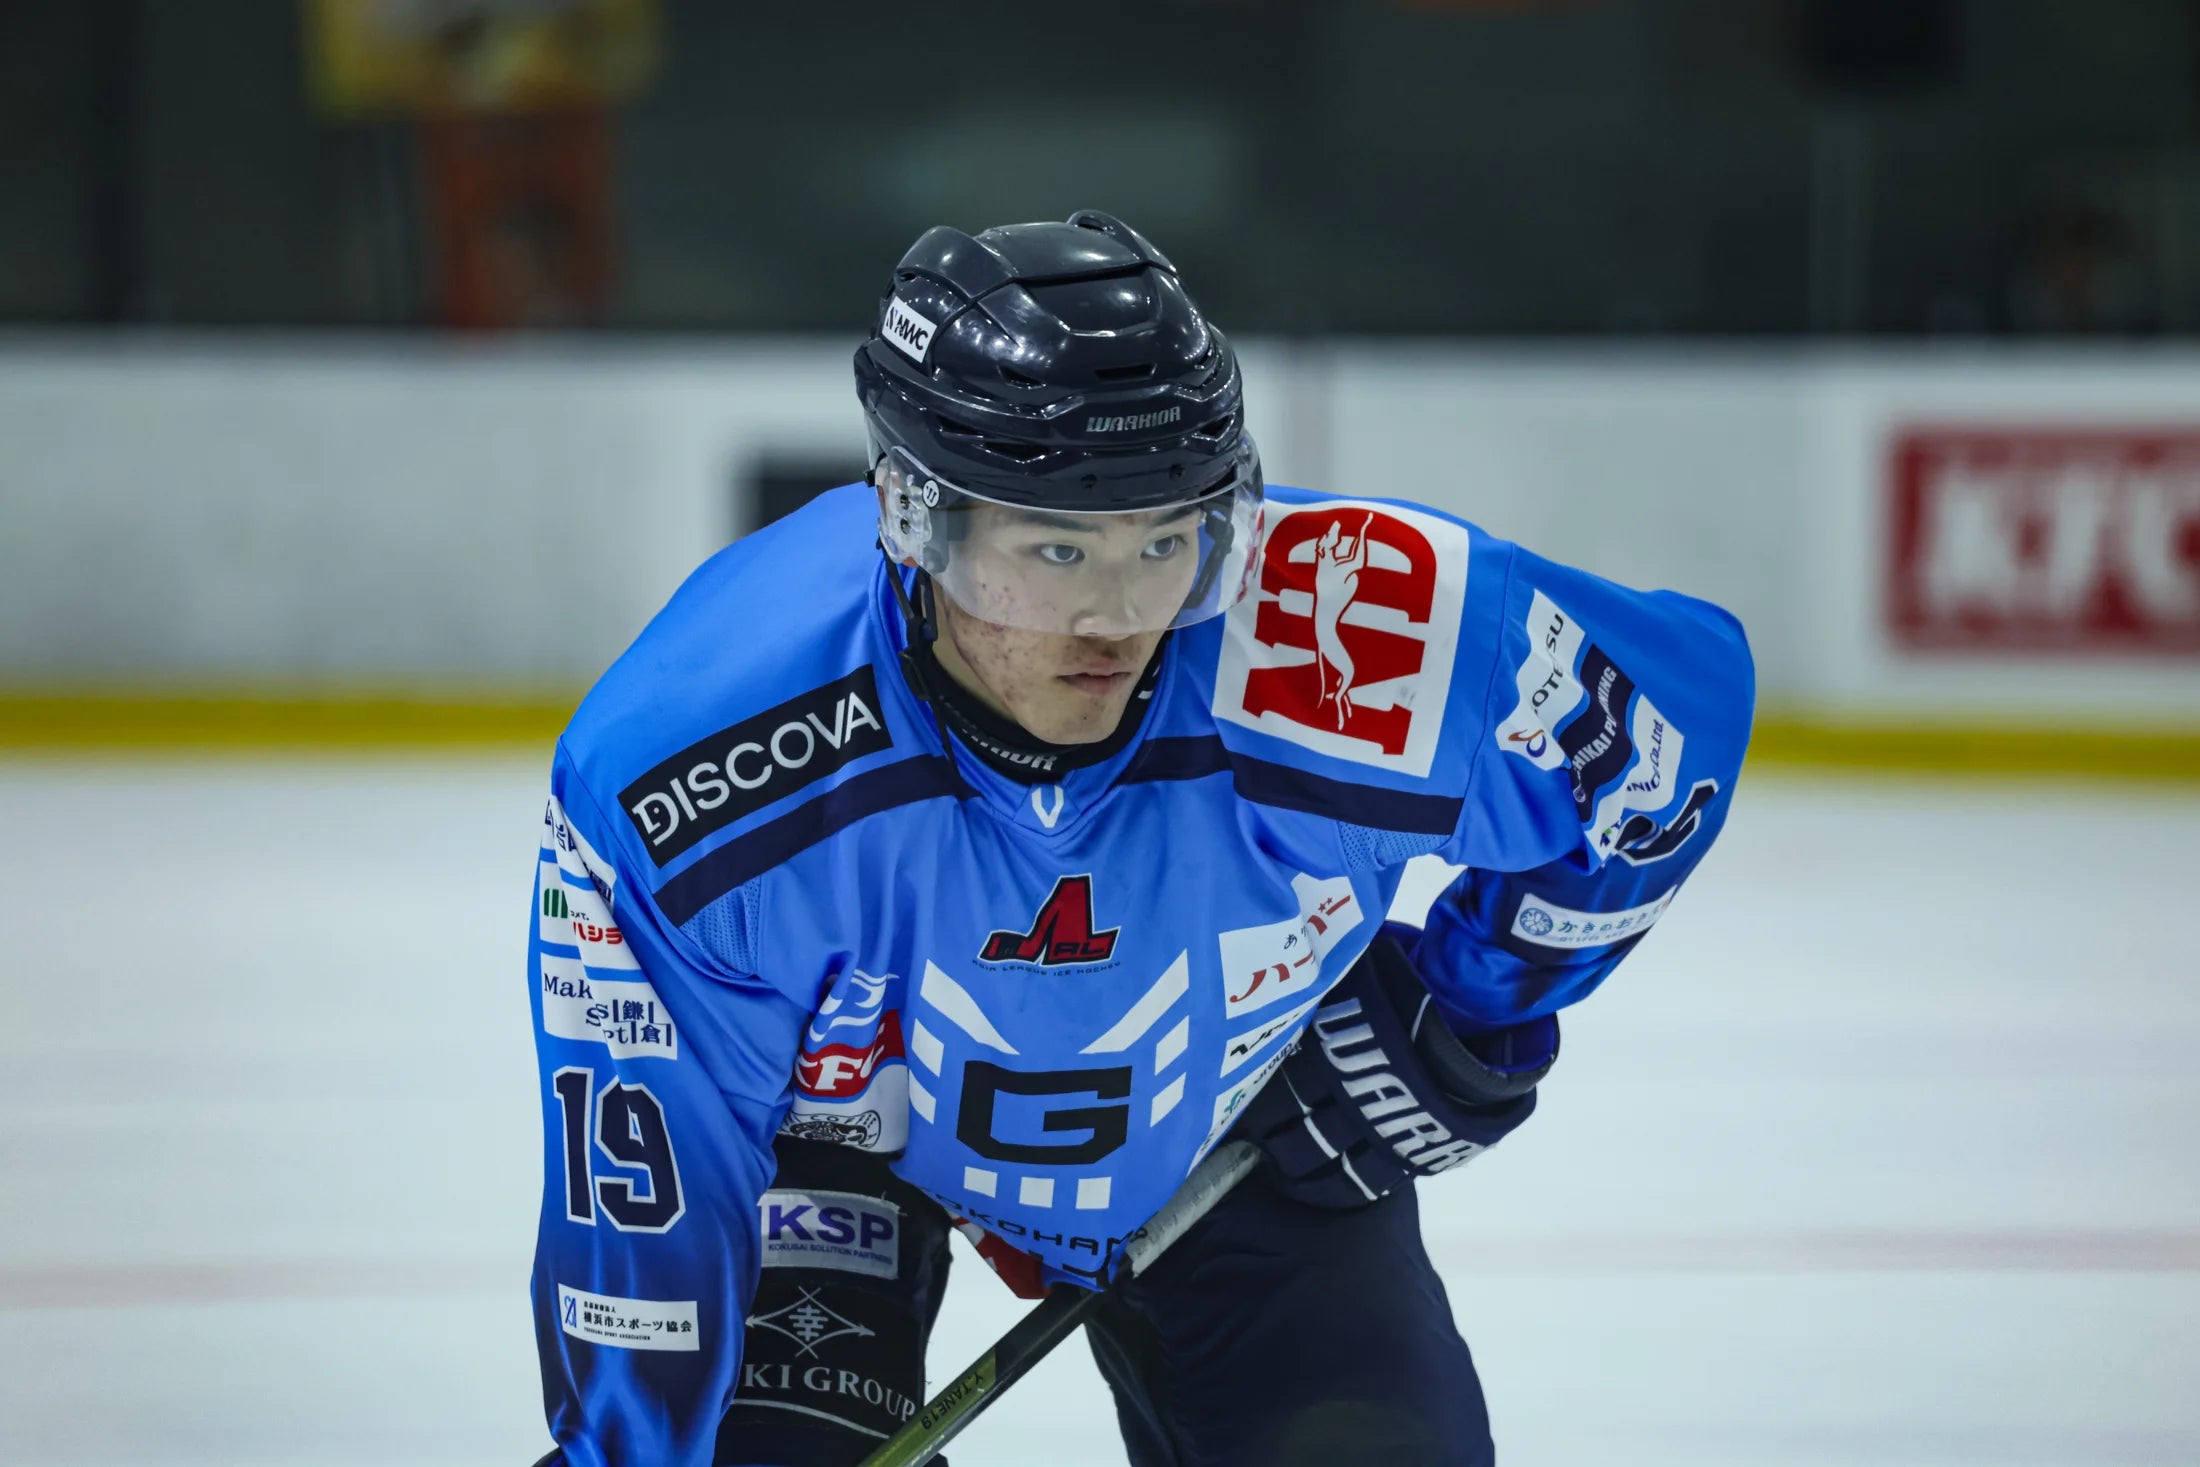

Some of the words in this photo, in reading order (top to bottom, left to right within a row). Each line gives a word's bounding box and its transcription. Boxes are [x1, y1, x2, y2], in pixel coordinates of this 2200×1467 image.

[1086, 406, 1180, 433] WARRIOR
[632, 691, 881, 847] DISCOVA
[956, 1060, 1132, 1165] G
[553, 1065, 686, 1233] 19
[769, 1205, 894, 1249] KSP
[584, 1312, 692, 1332] 横浜市スポーツ協会
[803, 1366, 916, 1421] GROUP
